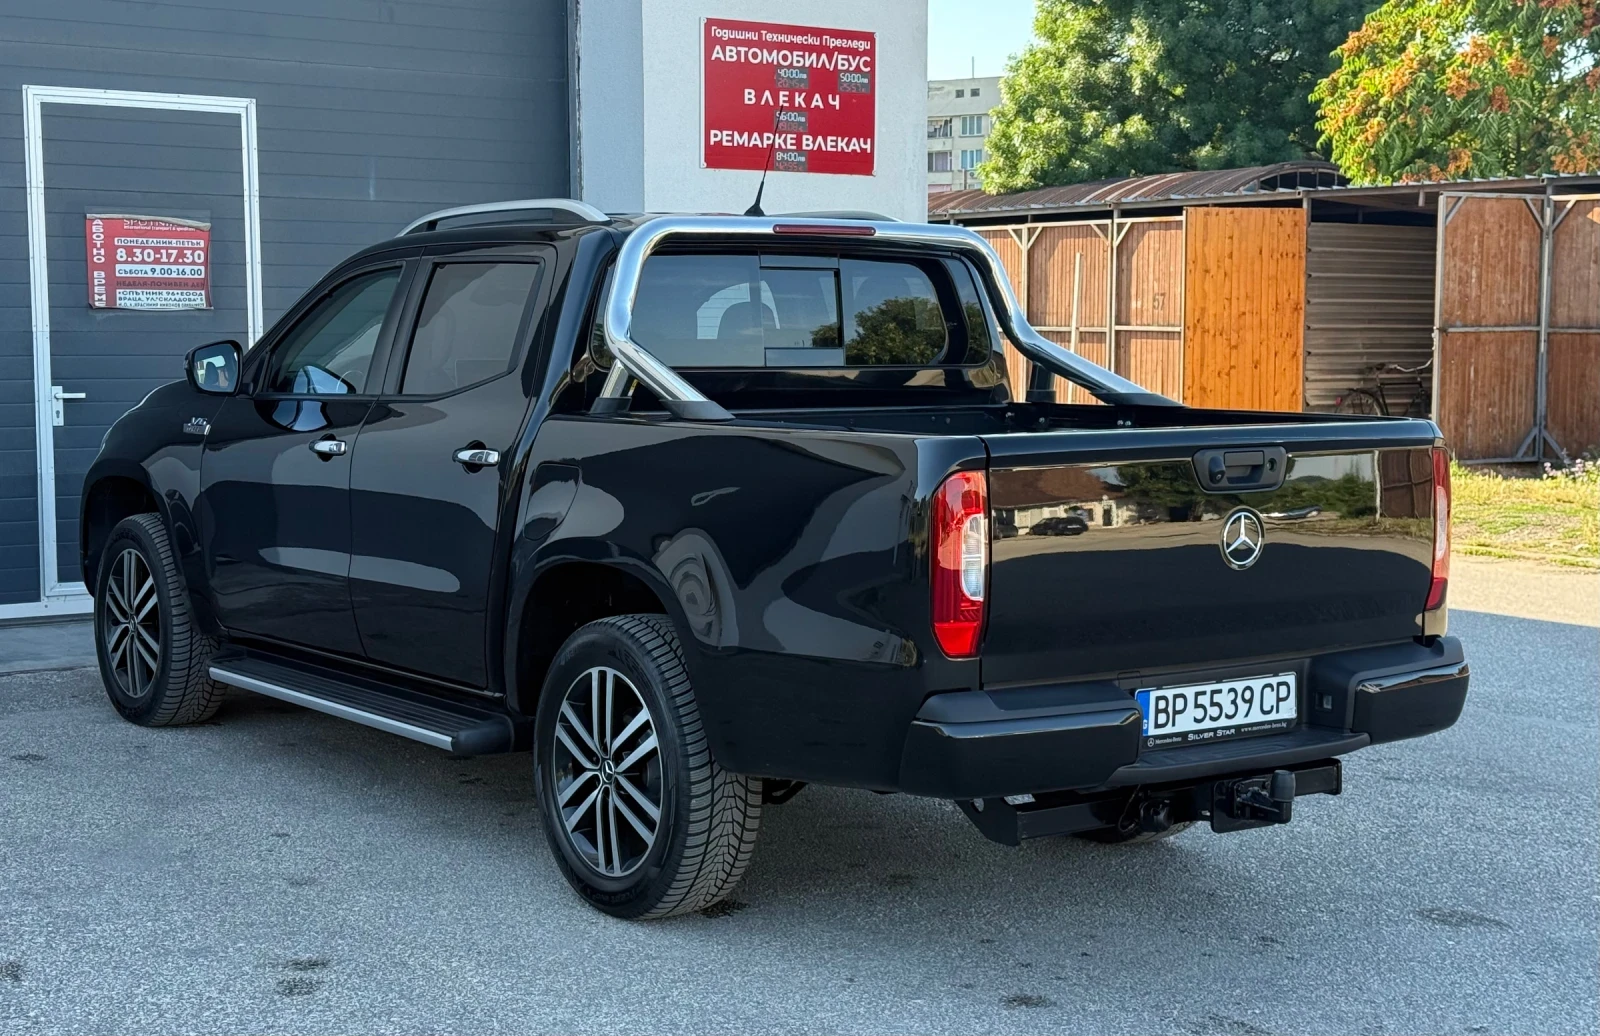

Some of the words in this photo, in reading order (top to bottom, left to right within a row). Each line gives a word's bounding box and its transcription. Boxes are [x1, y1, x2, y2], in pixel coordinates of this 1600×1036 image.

[711, 26, 758, 40] Годишни
[761, 30, 820, 45] Технически
[823, 35, 870, 51] Прегледи
[711, 45, 871, 72] АВТОМОБИЛ/БУС
[744, 88, 840, 110] ВЛЕКАЧ
[710, 130, 797, 150] РЕМАРКЕ
[802, 134, 871, 153] ВЛЕКАЧ
[116, 248, 205, 263] 8.30-17.30
[150, 267, 202, 276] 9.00-16.00
[1152, 292, 1166, 310] 57
[1154, 693, 1188, 729] BP
[1193, 685, 1254, 724] 5539
[1260, 681, 1291, 716] CP
